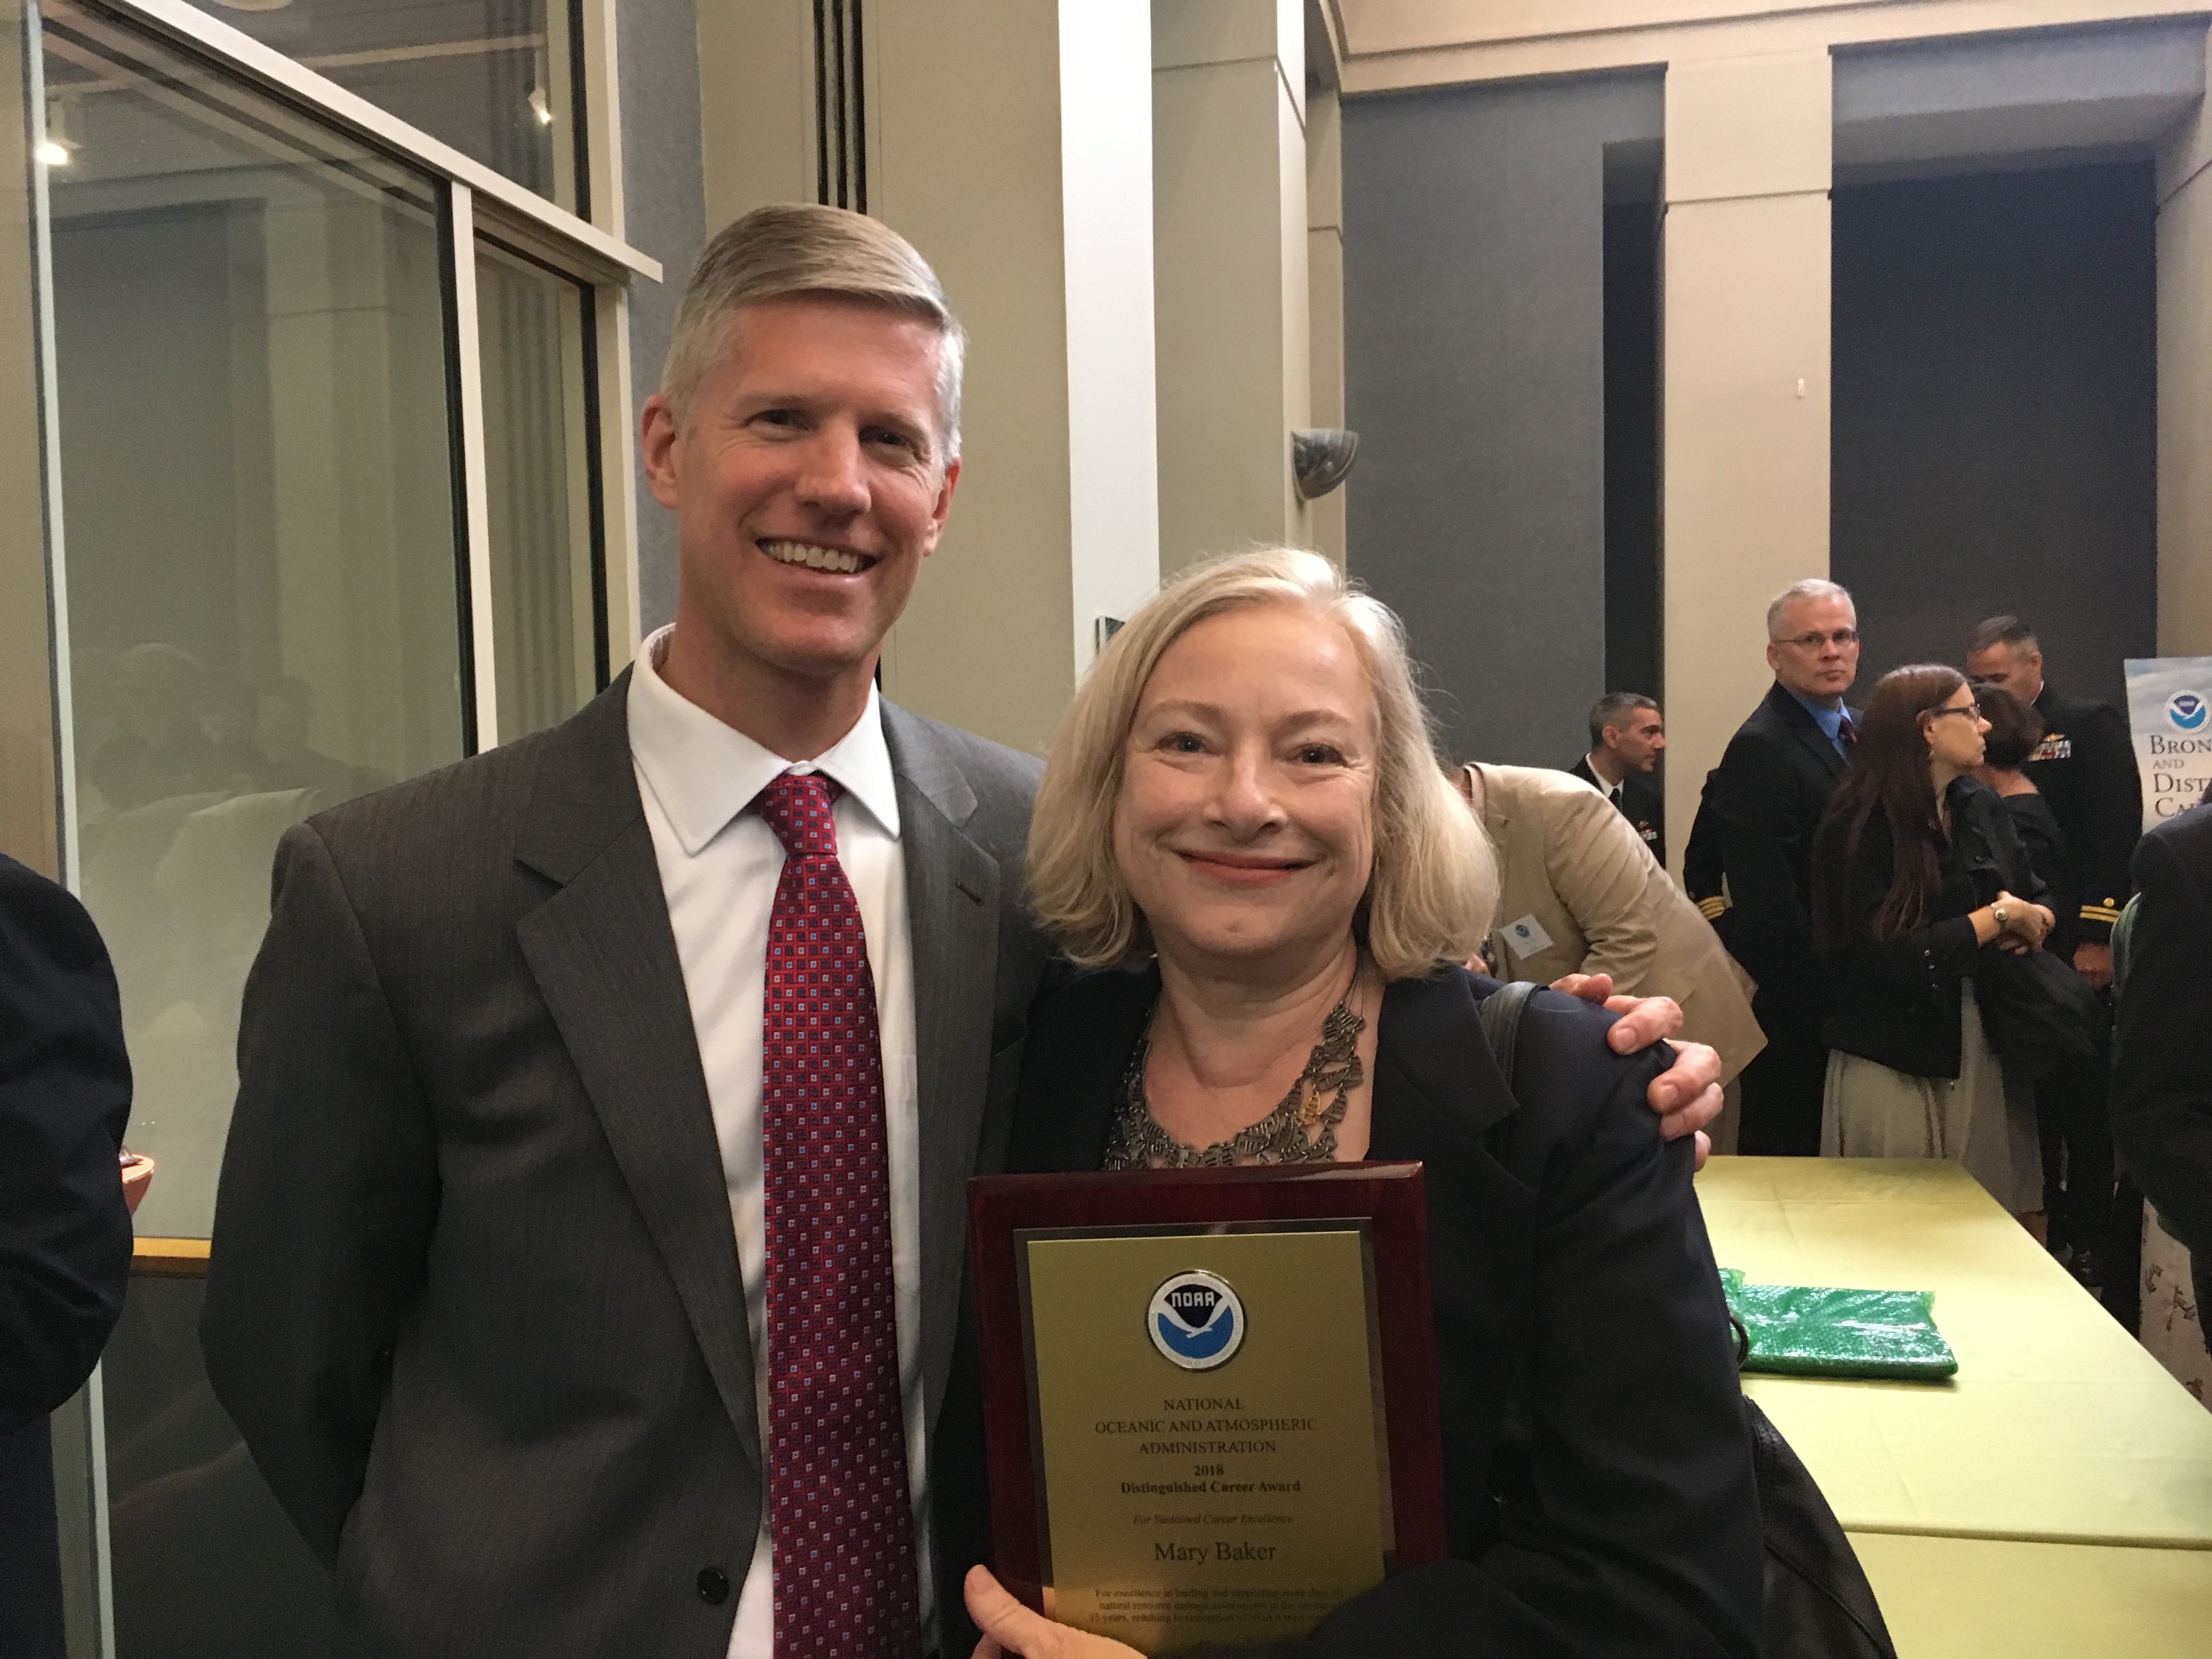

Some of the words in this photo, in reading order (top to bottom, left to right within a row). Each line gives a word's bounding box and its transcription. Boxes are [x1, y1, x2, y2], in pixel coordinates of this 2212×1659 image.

[2153, 759, 2185, 769] AND
[1171, 1291, 1215, 1307] NOAA
[1163, 1397, 1245, 1411] NATIONAL
[1095, 1420, 1165, 1434] OCEANIC
[1168, 1420, 1203, 1433] AND
[1206, 1418, 1317, 1432] ATMOSPHERIC
[1139, 1440, 1277, 1454] ADMINISTRATION
[1194, 1464, 1224, 1476] 2018
[1121, 1481, 1206, 1495] Distinguished
[1210, 1481, 1255, 1493] Career
[1259, 1480, 1301, 1492] Award
[1133, 1514, 1150, 1525] For
[1153, 1513, 1201, 1525] Sustained
[1204, 1513, 1237, 1523] Career
[1241, 1513, 1293, 1523] Excellence
[1154, 1542, 1207, 1565] Mary
[1215, 1541, 1277, 1561] Baker
[1096, 1589, 1111, 1597] For
[1114, 1589, 1161, 1597] excellence
[1099, 1601, 1130, 1610] natural
[1133, 1602, 1171, 1610] resource
[1174, 1601, 1209, 1611] damage
